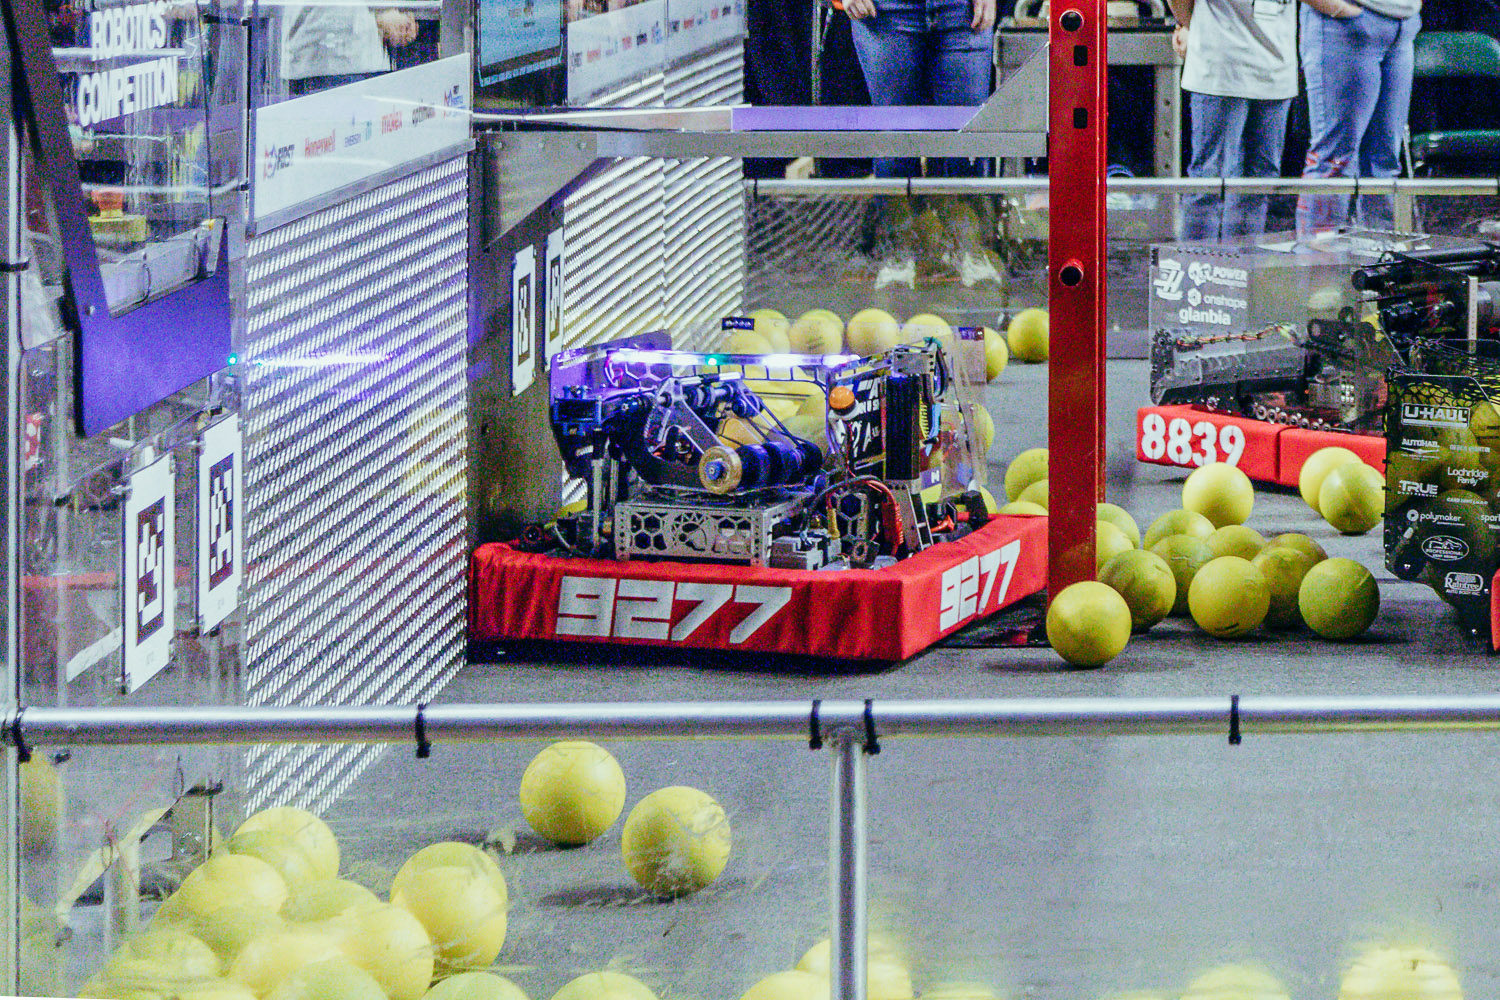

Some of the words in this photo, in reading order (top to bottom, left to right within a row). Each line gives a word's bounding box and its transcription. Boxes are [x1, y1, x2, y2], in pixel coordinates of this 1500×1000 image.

[91, 0, 167, 62] ROBOTICS
[78, 56, 178, 128] COMPETITION
[1179, 306, 1232, 326] glanbia
[1140, 413, 1246, 467] 8839
[1399, 480, 1438, 495] TRUE
[1447, 466, 1489, 479] Lochridge
[1457, 476, 1479, 487] Family
[1420, 511, 1462, 523] polymaker
[940, 538, 1021, 633] 9277
[555, 575, 793, 644] 9277
